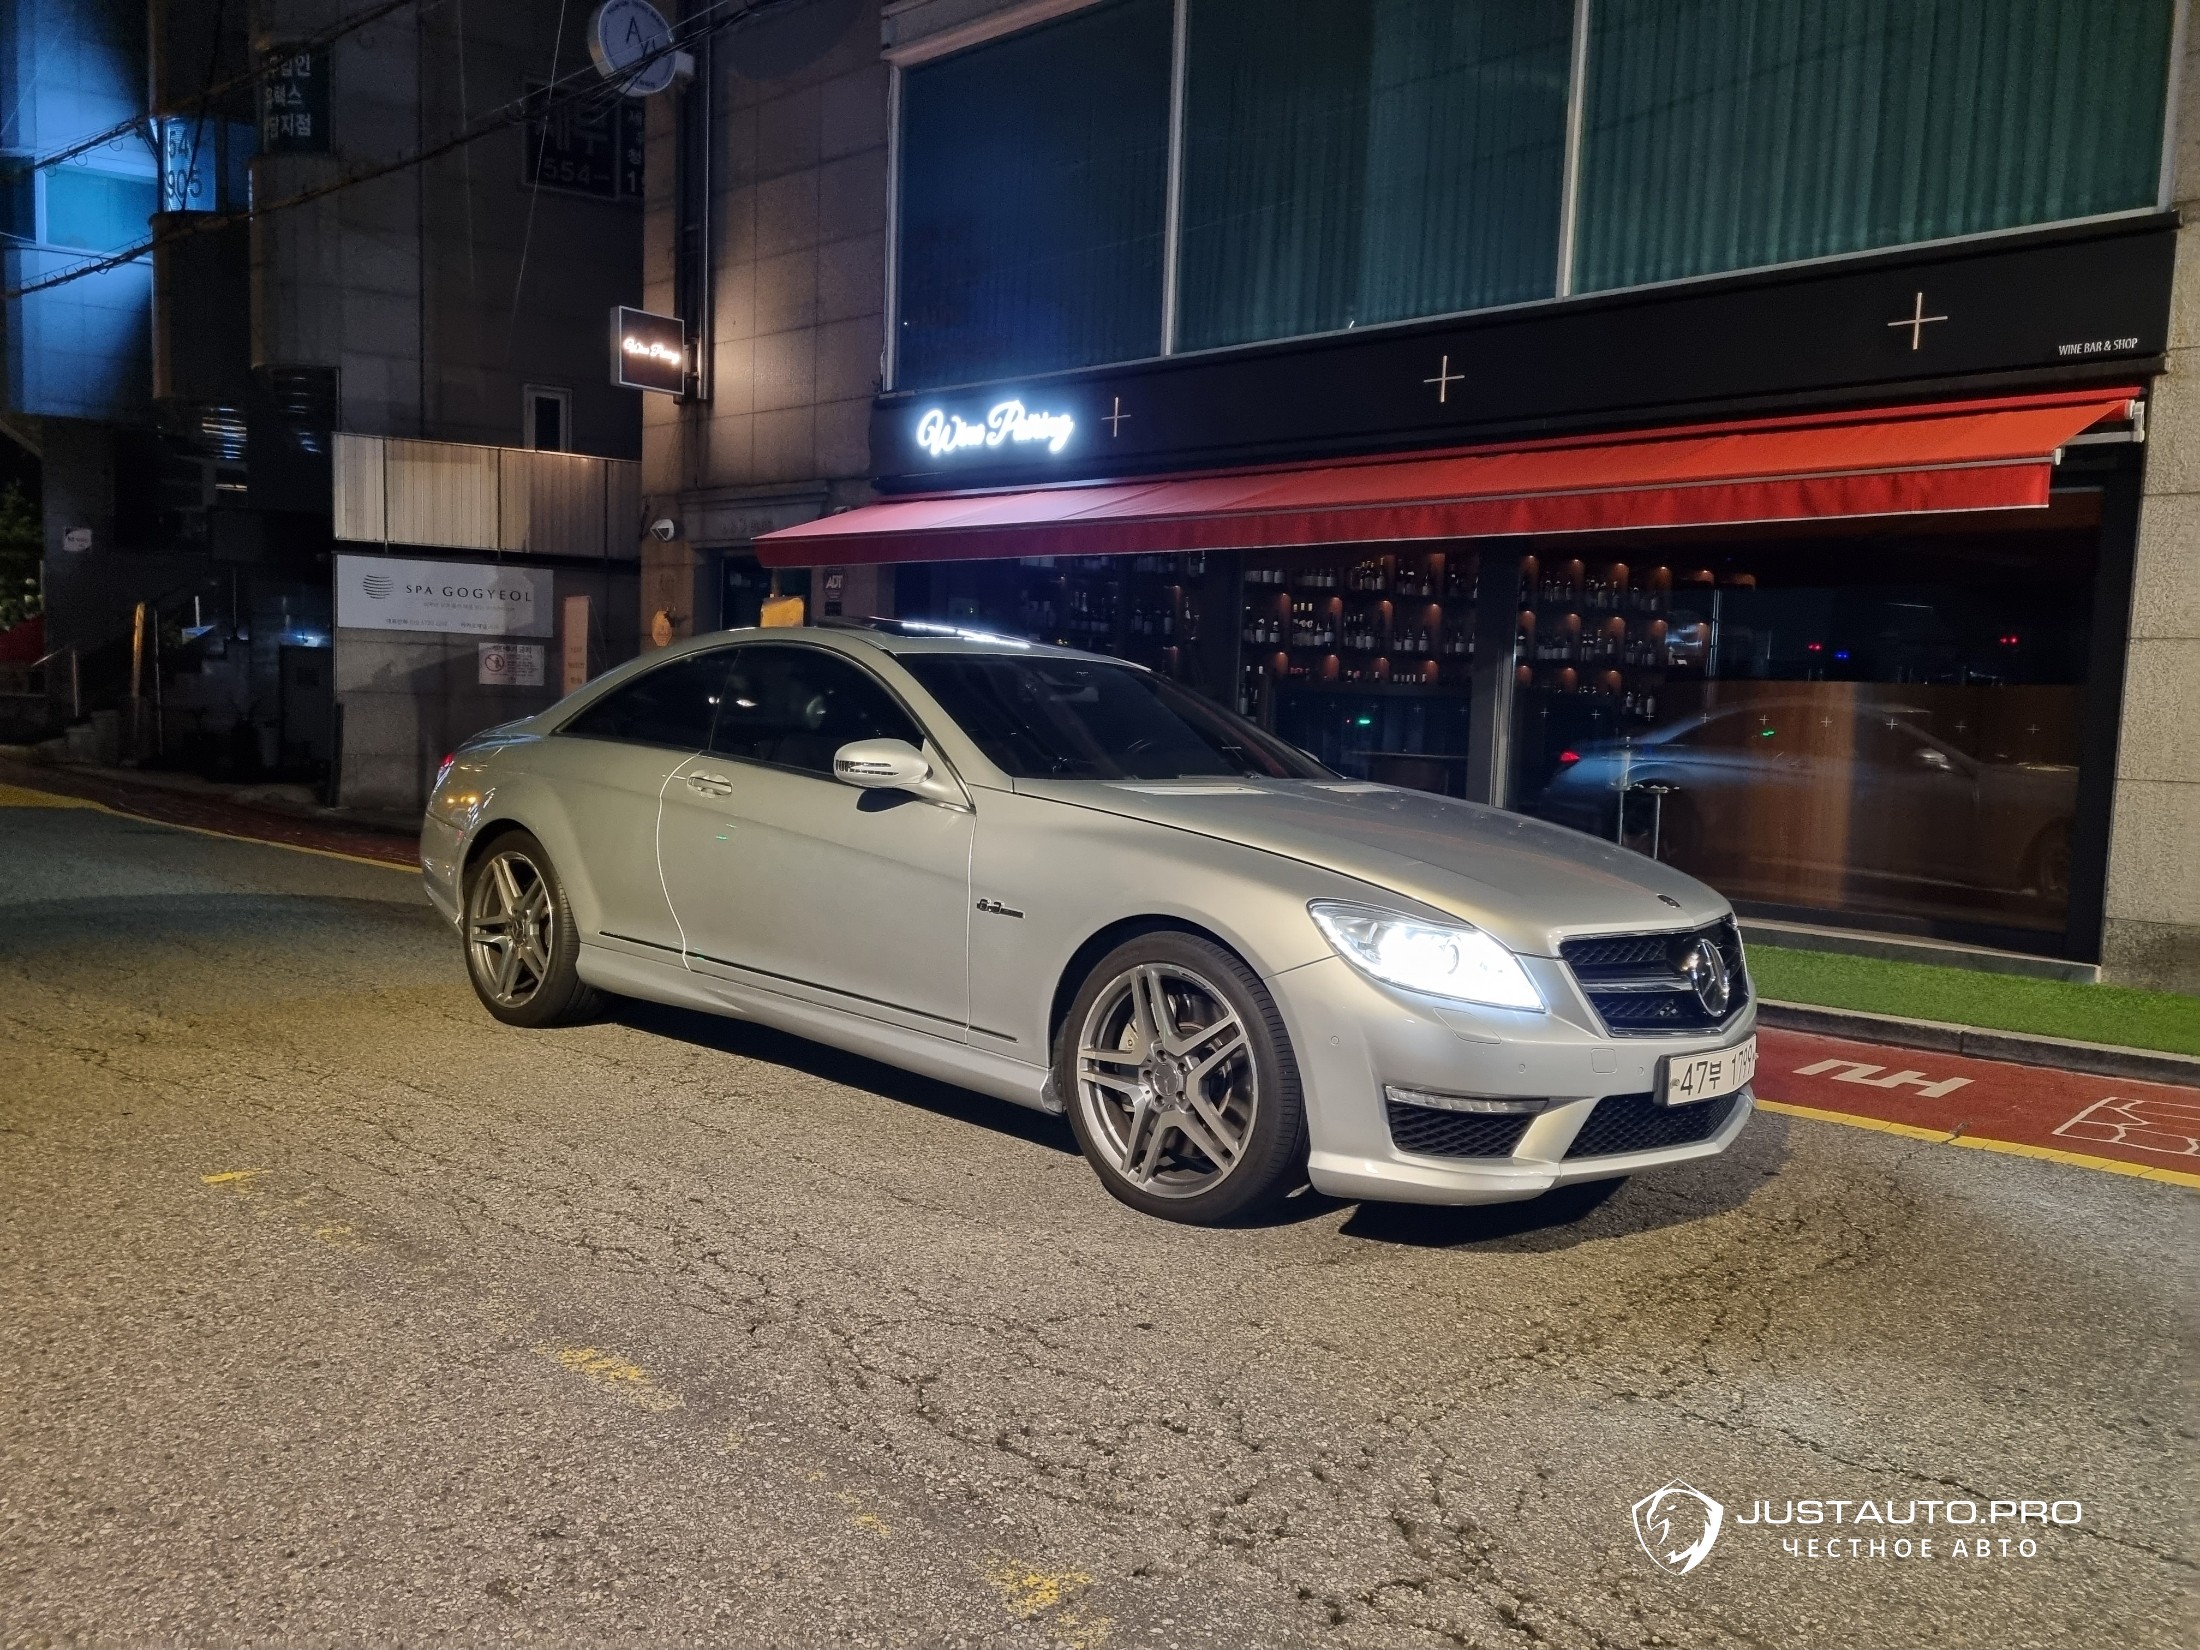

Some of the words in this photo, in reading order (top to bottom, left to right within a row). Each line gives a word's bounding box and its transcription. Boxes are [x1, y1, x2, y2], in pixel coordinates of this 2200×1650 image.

[2058, 343, 2082, 356] WINE
[2084, 341, 2102, 353] BAR
[2103, 340, 2111, 351] &
[2113, 337, 2138, 350] SHOP
[825, 574, 844, 589] ADT
[406, 585, 433, 596] SPA
[442, 586, 532, 602] GOGYEOL
[1680, 1060, 1722, 1096] 47부
